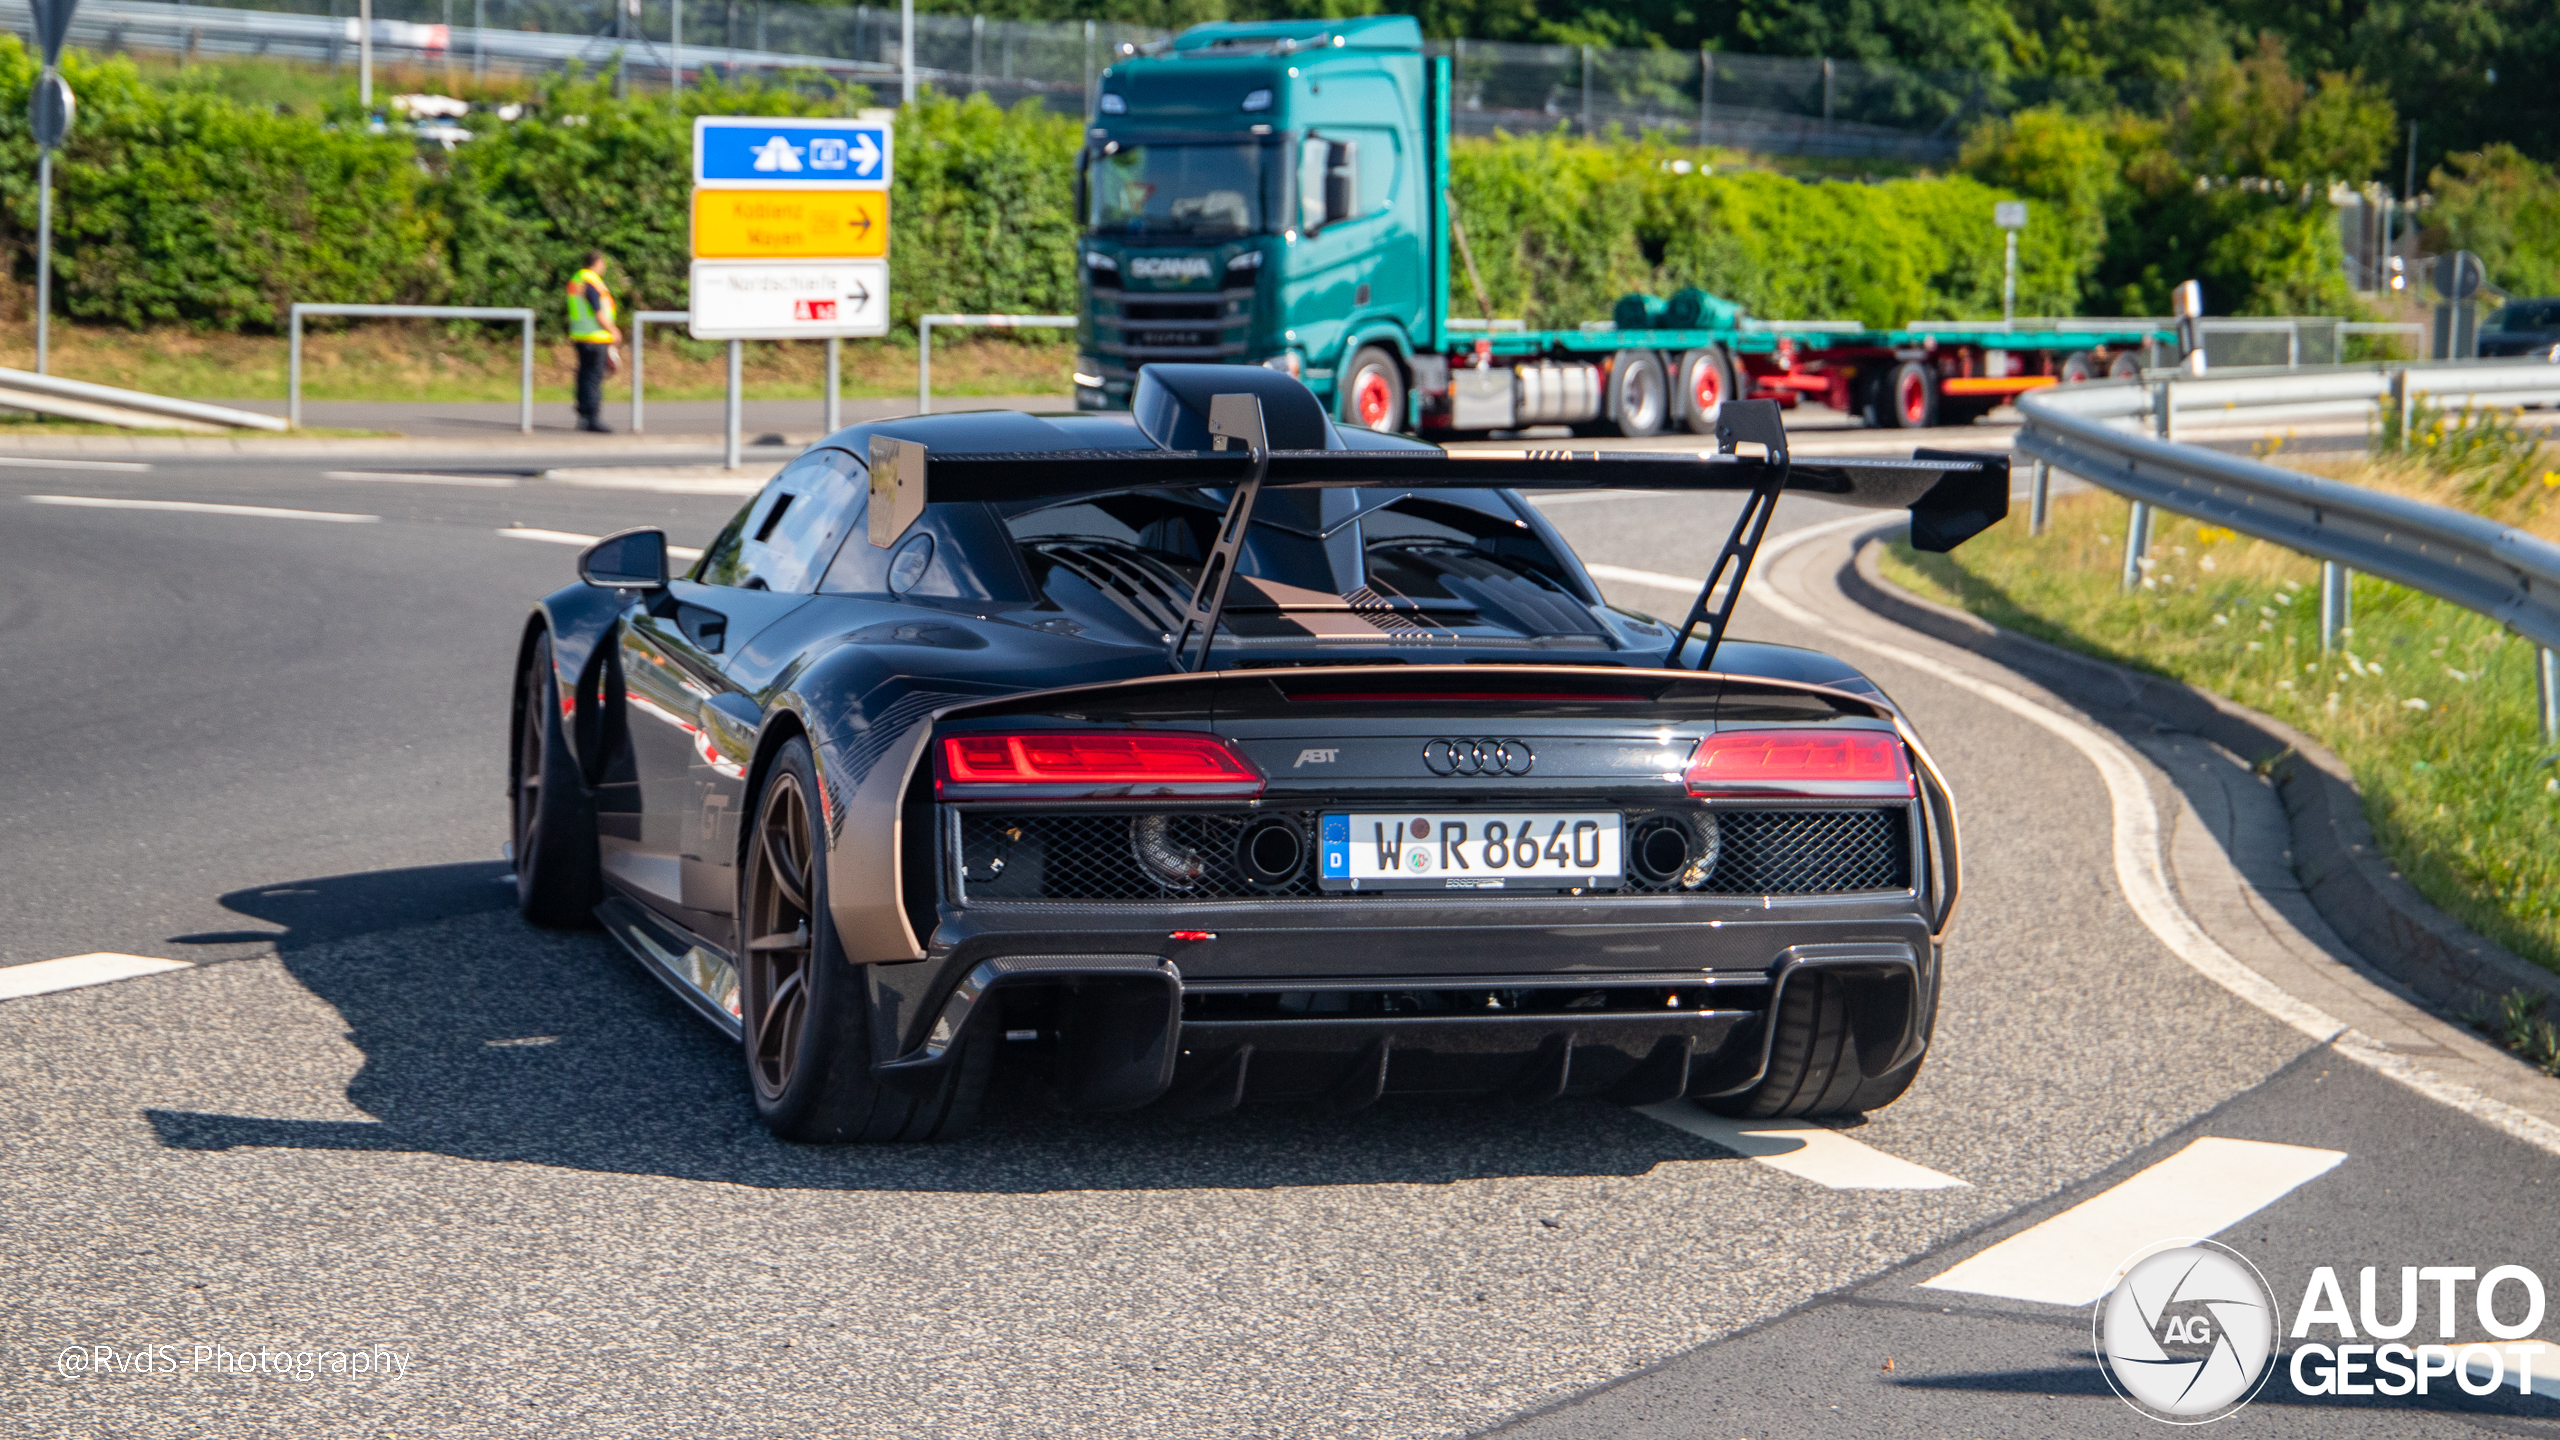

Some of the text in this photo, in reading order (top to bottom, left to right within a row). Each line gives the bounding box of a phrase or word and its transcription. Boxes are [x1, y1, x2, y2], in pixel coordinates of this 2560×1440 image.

[1130, 257, 1213, 279] SCANIA
[1293, 748, 1339, 768] ABT
[1374, 820, 1600, 870] W R 8640
[1329, 852, 1342, 868] D
